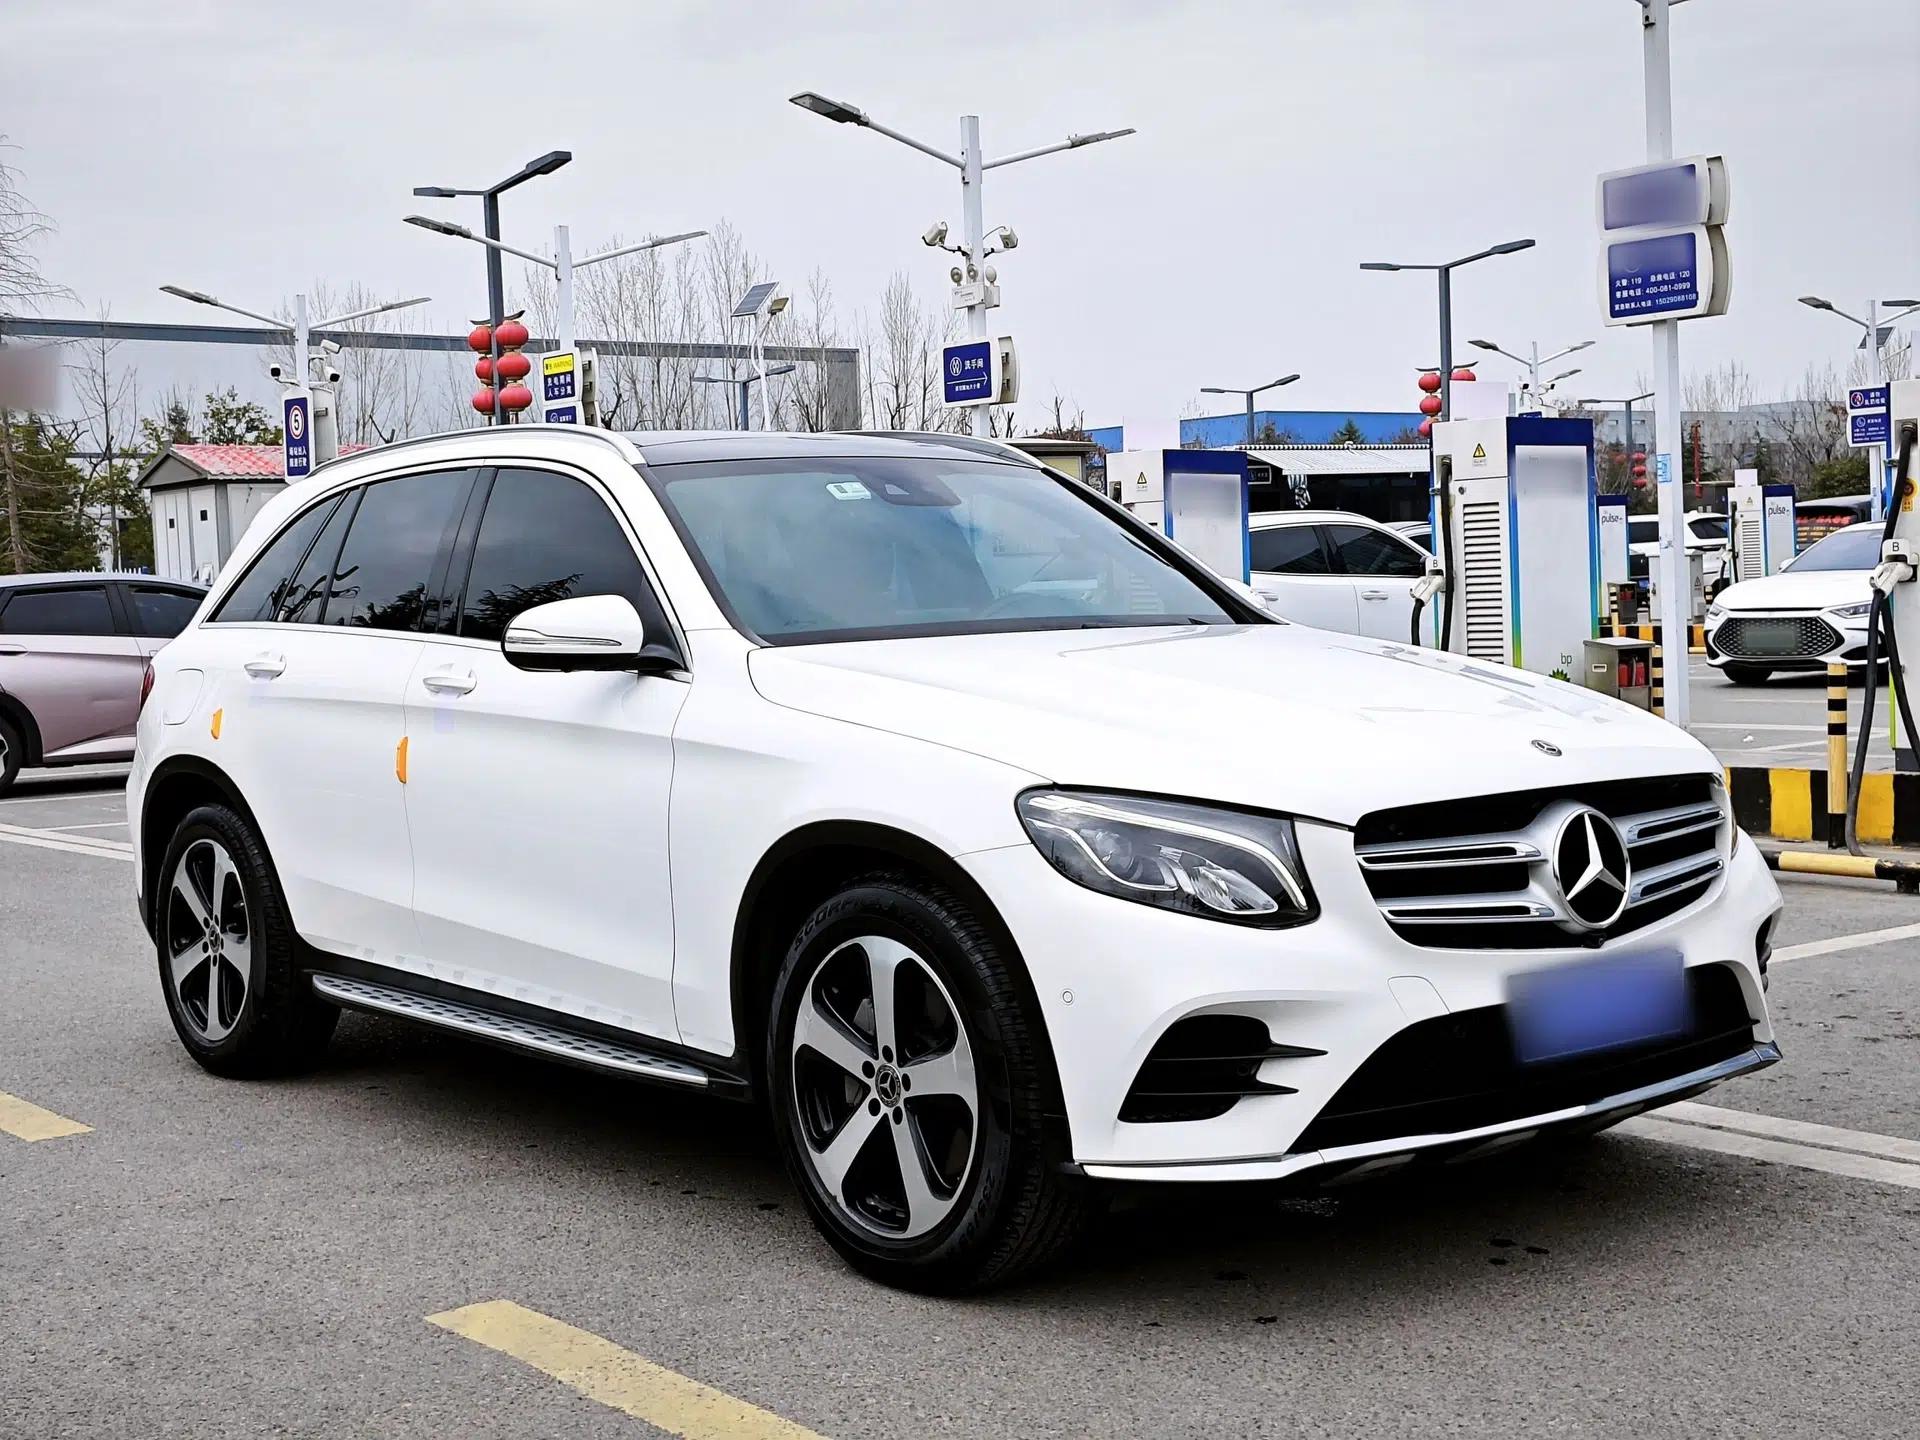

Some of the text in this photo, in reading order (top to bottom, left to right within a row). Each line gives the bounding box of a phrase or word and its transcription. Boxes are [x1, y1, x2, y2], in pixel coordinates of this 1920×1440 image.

[1679, 270, 1690, 278] 120
[293, 414, 300, 431] 5
[1767, 504, 1786, 518] pulse
[1601, 513, 1619, 526] pulse
[1892, 541, 1900, 552] B
[1432, 559, 1439, 568] B
[1560, 652, 1573, 667] bp
